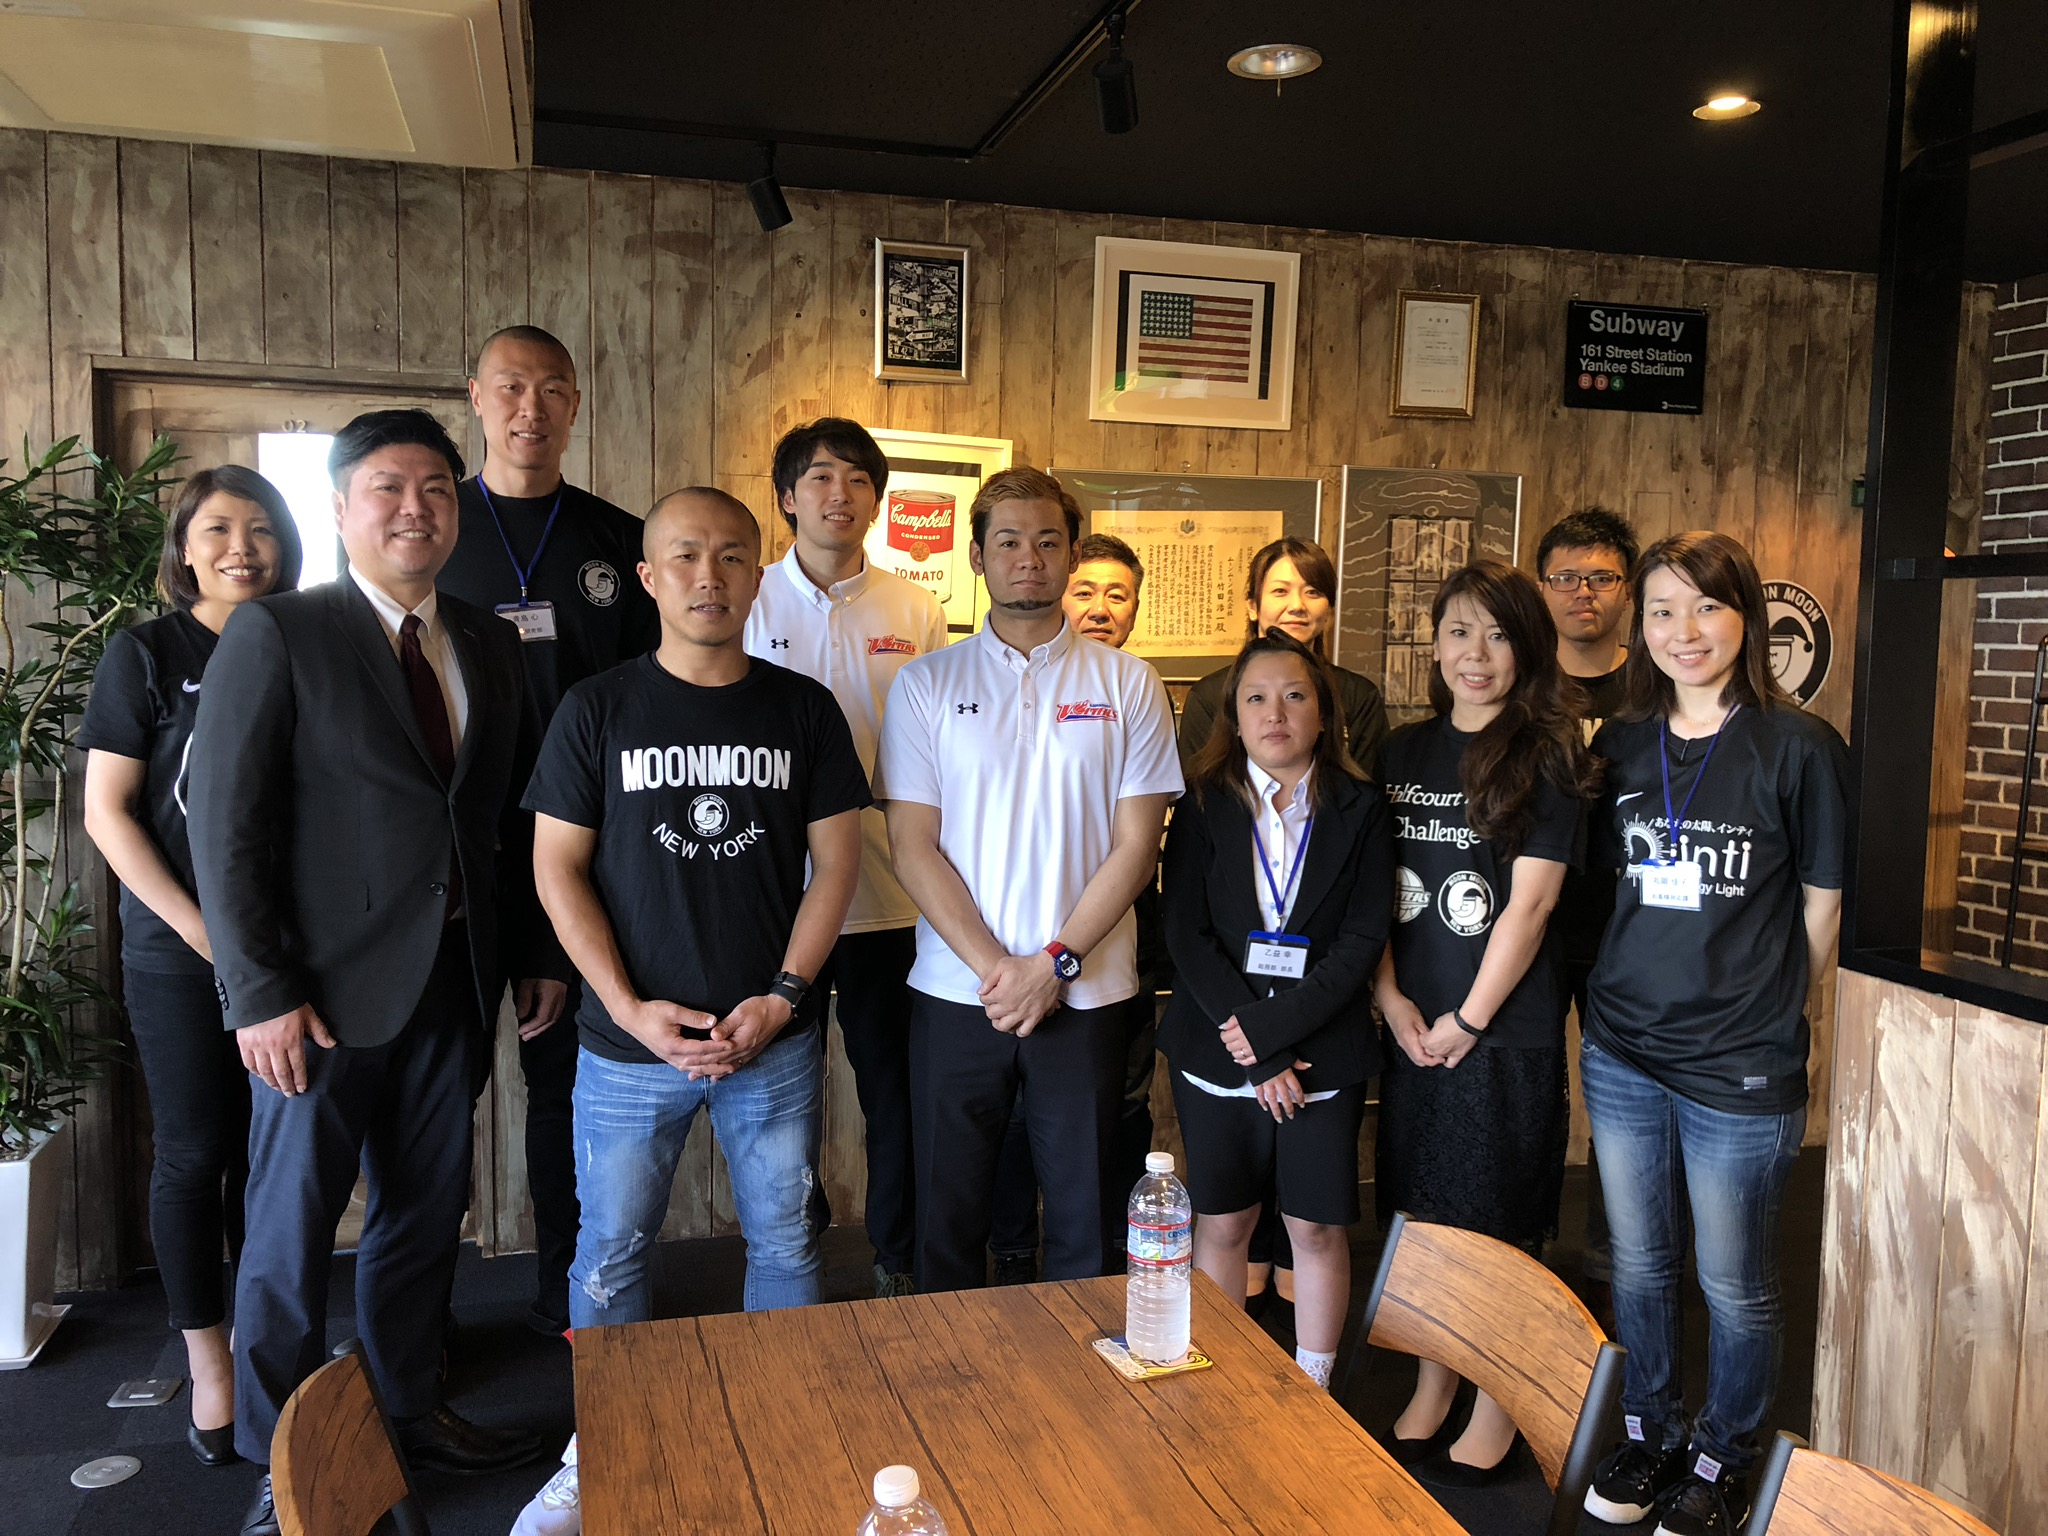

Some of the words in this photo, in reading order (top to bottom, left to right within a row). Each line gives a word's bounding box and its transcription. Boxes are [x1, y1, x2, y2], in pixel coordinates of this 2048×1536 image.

[1589, 309, 1684, 342] Subway
[1580, 344, 1602, 357] 161
[1605, 345, 1644, 360] Street
[1646, 348, 1692, 363] Station
[1579, 358, 1628, 374] Yankee
[1630, 361, 1684, 377] Stadium
[900, 532, 941, 540] CONDENSED
[894, 566, 944, 581] TOMATO
[1783, 586, 1822, 623] MOON
[620, 745, 792, 793] MOONMOON
[652, 822, 700, 860] NEW
[708, 821, 766, 861] YORK
[1679, 834, 1752, 880] inti
[1715, 883, 1746, 898] Light
